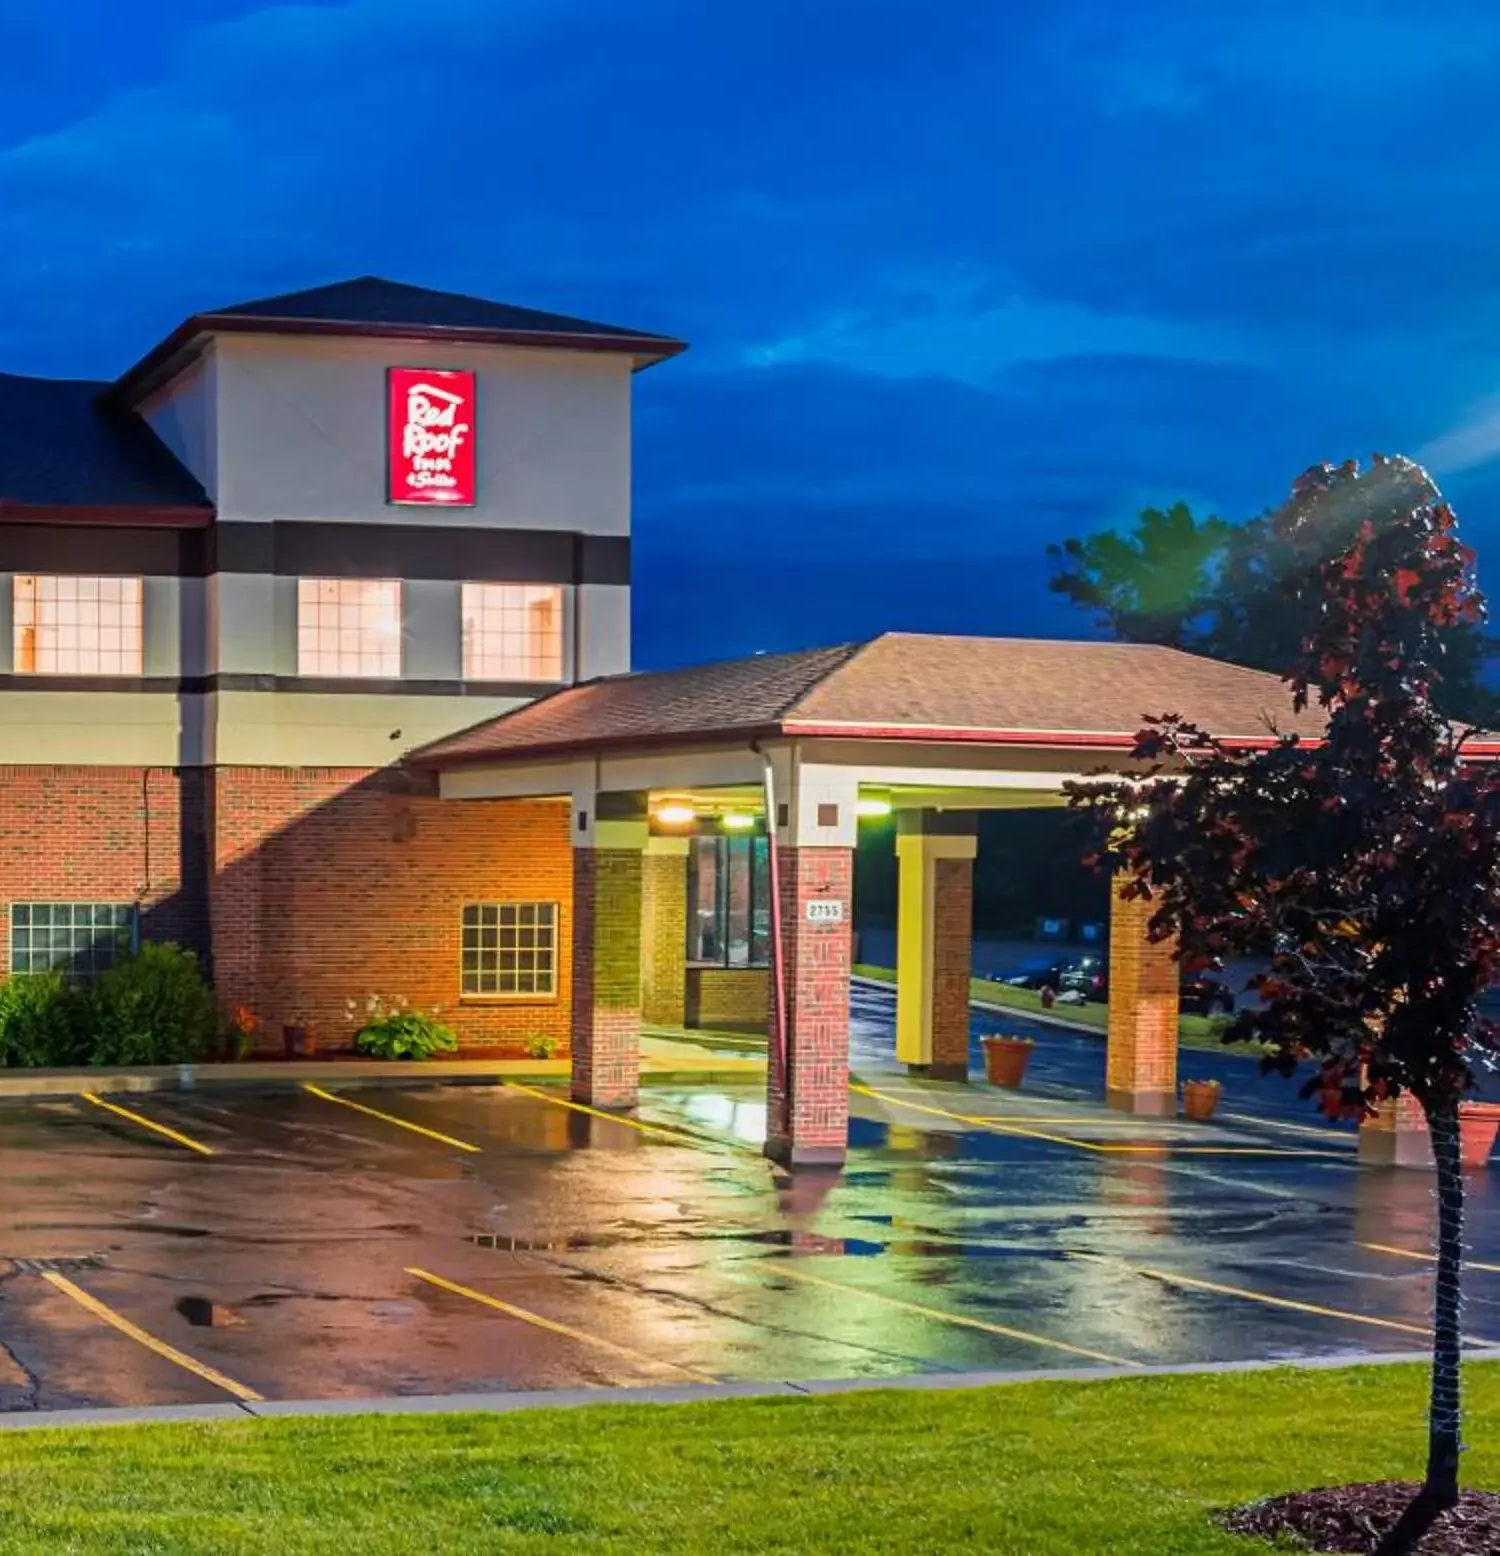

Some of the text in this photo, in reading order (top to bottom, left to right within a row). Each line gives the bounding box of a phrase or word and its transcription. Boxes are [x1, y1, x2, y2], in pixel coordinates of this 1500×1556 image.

[408, 395, 456, 427] Red
[403, 422, 468, 459] Roof
[413, 456, 452, 471] Inn
[809, 904, 839, 917] 2755
